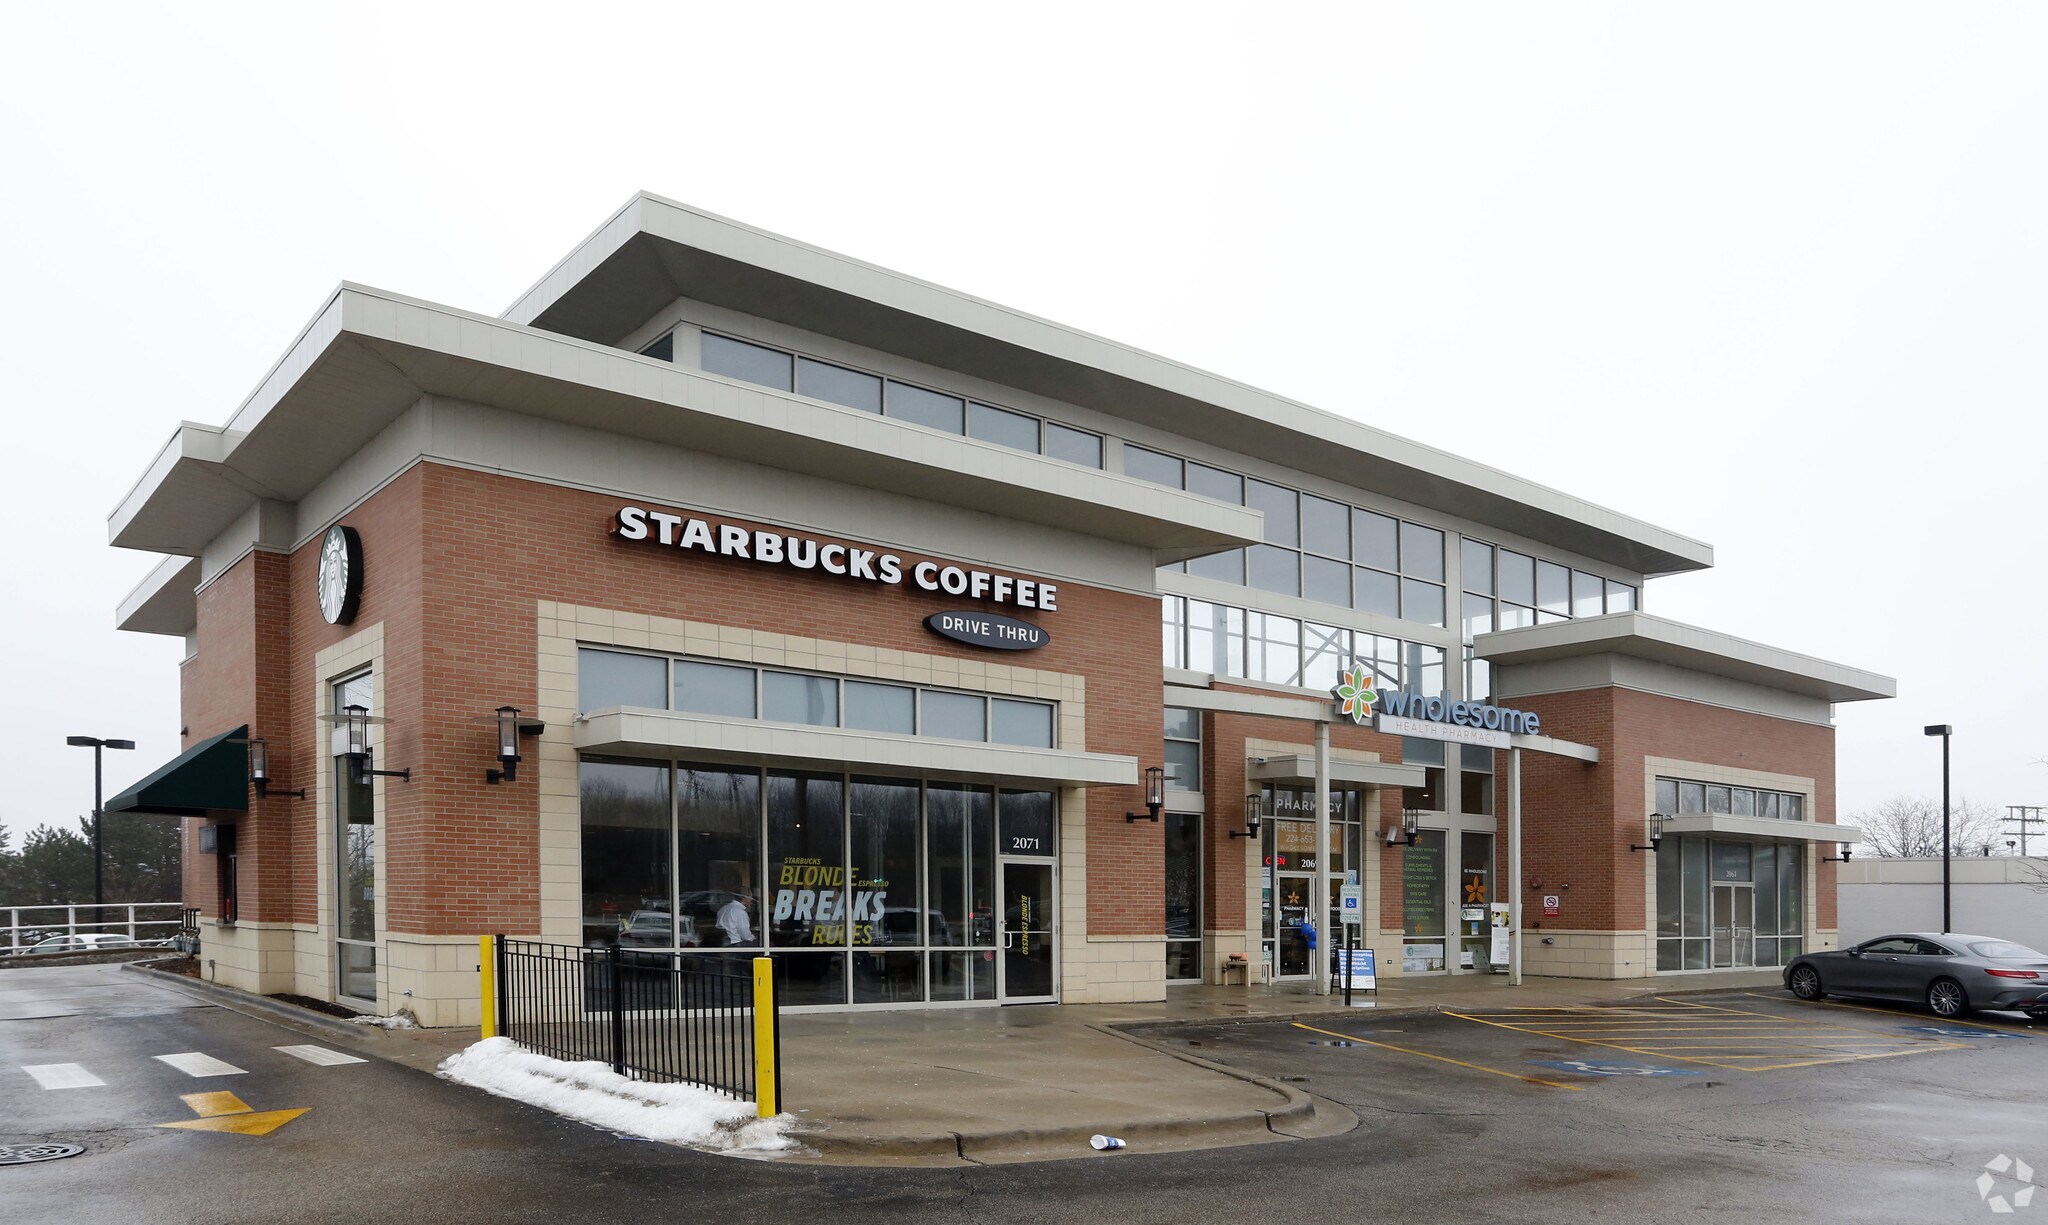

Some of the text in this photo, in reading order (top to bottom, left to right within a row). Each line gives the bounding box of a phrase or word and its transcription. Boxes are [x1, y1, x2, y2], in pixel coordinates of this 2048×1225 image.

[618, 506, 1058, 612] STARBUCKS COFFEE
[942, 616, 1039, 643] DRIVE THRU
[1382, 684, 1540, 735] wholesome
[1395, 720, 1498, 743] HEALTH PHARMACY
[1276, 798, 1342, 813] PHARMCY
[1276, 821, 1297, 832] FREE
[1012, 836, 1039, 850] 2071
[783, 857, 821, 865] STARBUCKS
[780, 865, 889, 888] BLONDE ESPRESSO
[773, 889, 887, 921] BREAKS
[811, 924, 874, 945] RULES
